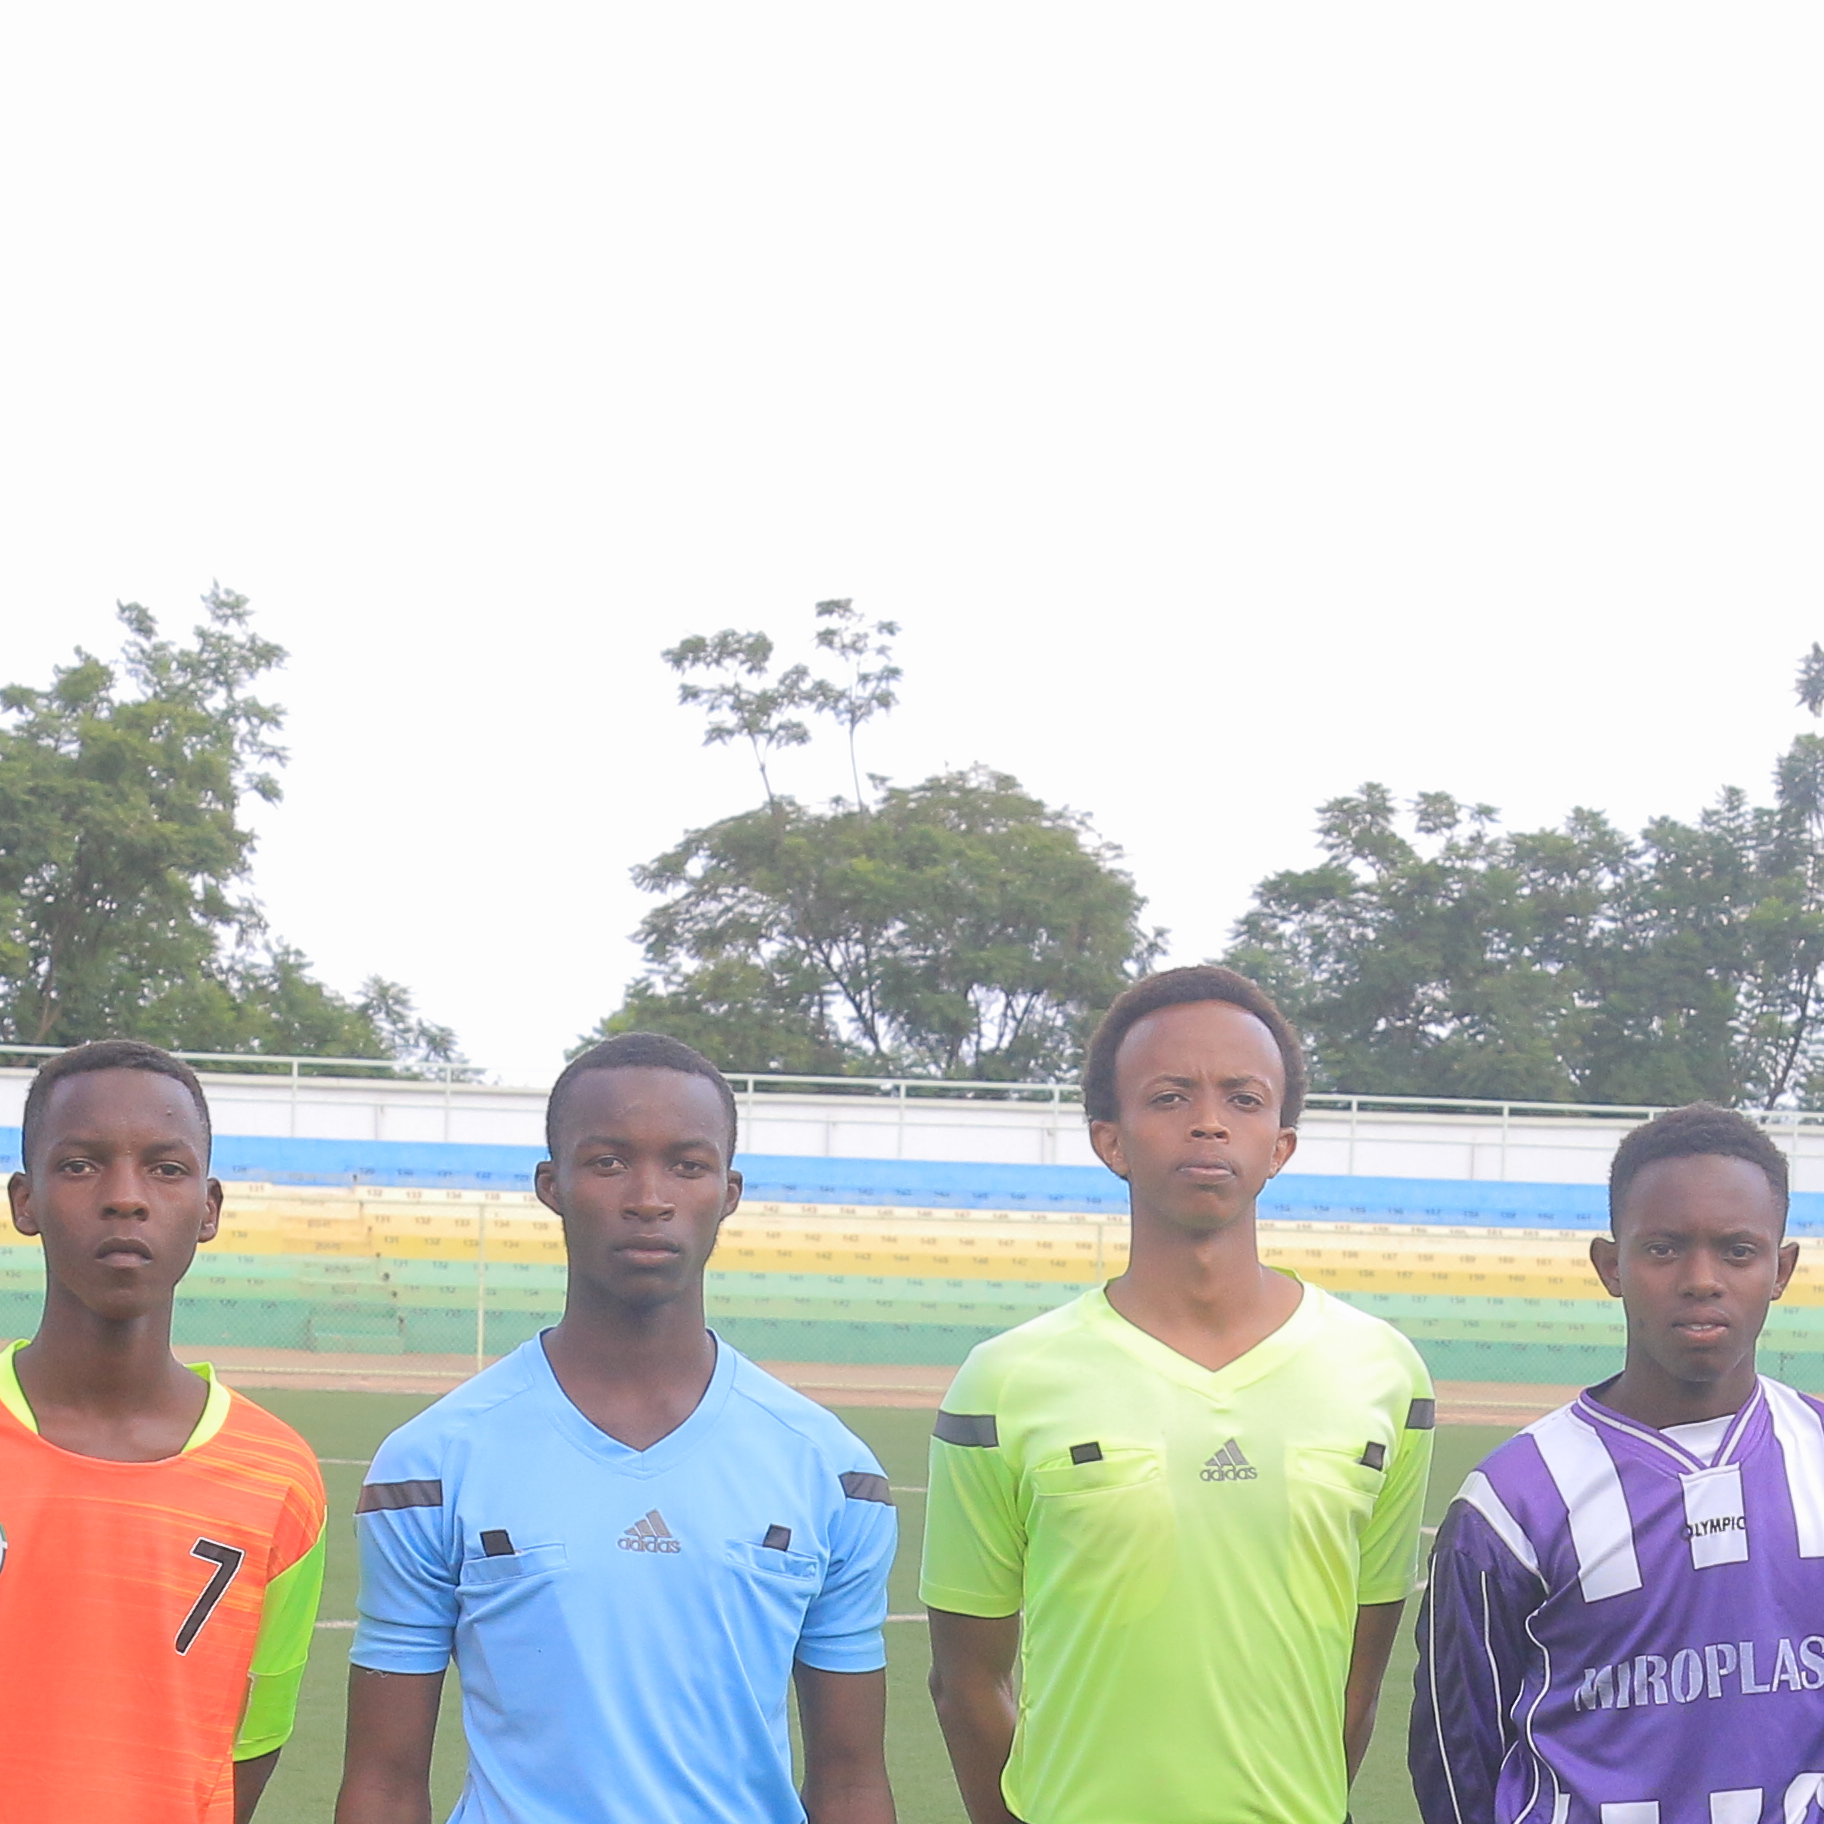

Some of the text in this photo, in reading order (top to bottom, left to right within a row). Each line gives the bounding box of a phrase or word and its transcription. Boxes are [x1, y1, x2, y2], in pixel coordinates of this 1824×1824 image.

[1199, 1464, 1258, 1482] adidas
[1680, 1515, 1747, 1541] OLYMPIC
[617, 1536, 682, 1554] adidas
[173, 1535, 246, 1657] 7
